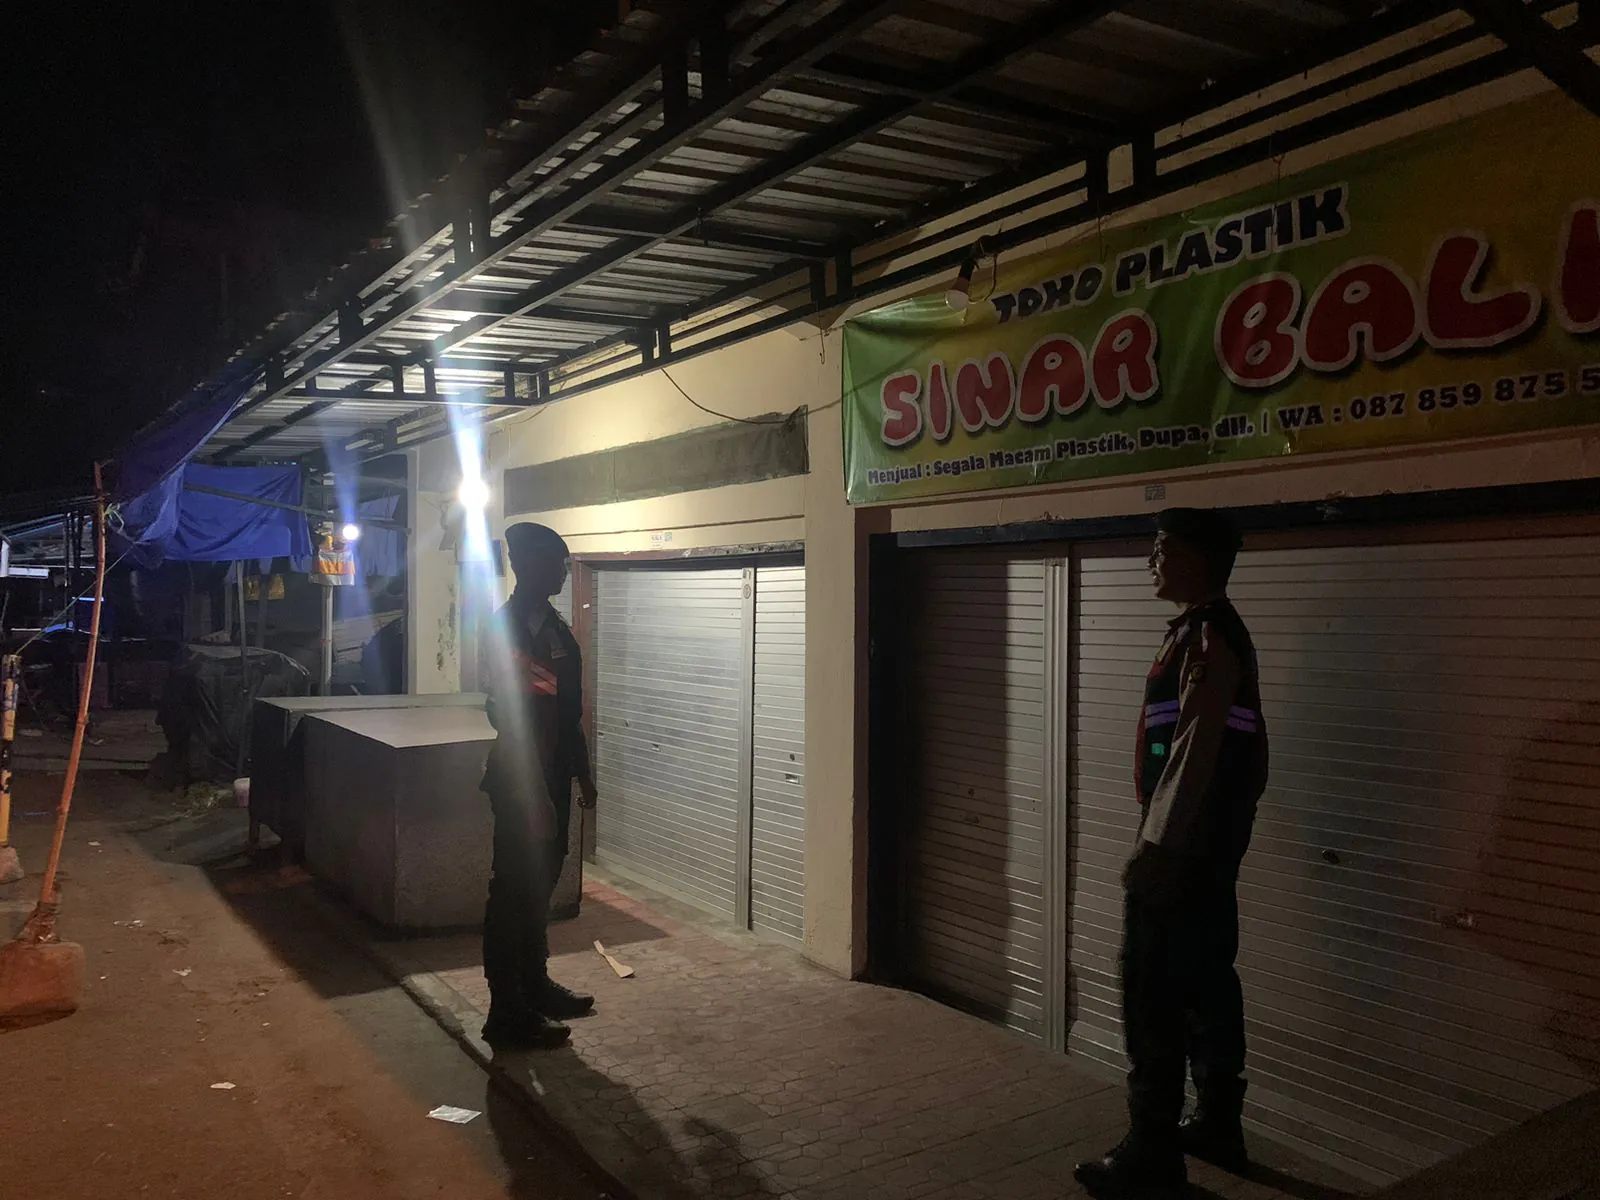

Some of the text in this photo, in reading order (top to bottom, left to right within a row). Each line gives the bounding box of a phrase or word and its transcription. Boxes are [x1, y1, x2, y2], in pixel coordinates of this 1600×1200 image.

[993, 183, 1349, 324] TOKO PLASTIK
[867, 465, 922, 484] Menjual
[933, 456, 986, 476] Segala
[989, 447, 1052, 468] Macam
[1056, 435, 1136, 459] Plastik,
[1140, 424, 1210, 449] Dupa,
[1214, 415, 1254, 438] dll.
[1277, 404, 1325, 429] WA
[1350, 393, 1406, 420] 087
[1418, 382, 1482, 411] 859
[1495, 371, 1566, 401] 875
[881, 309, 1159, 445] SINAR
